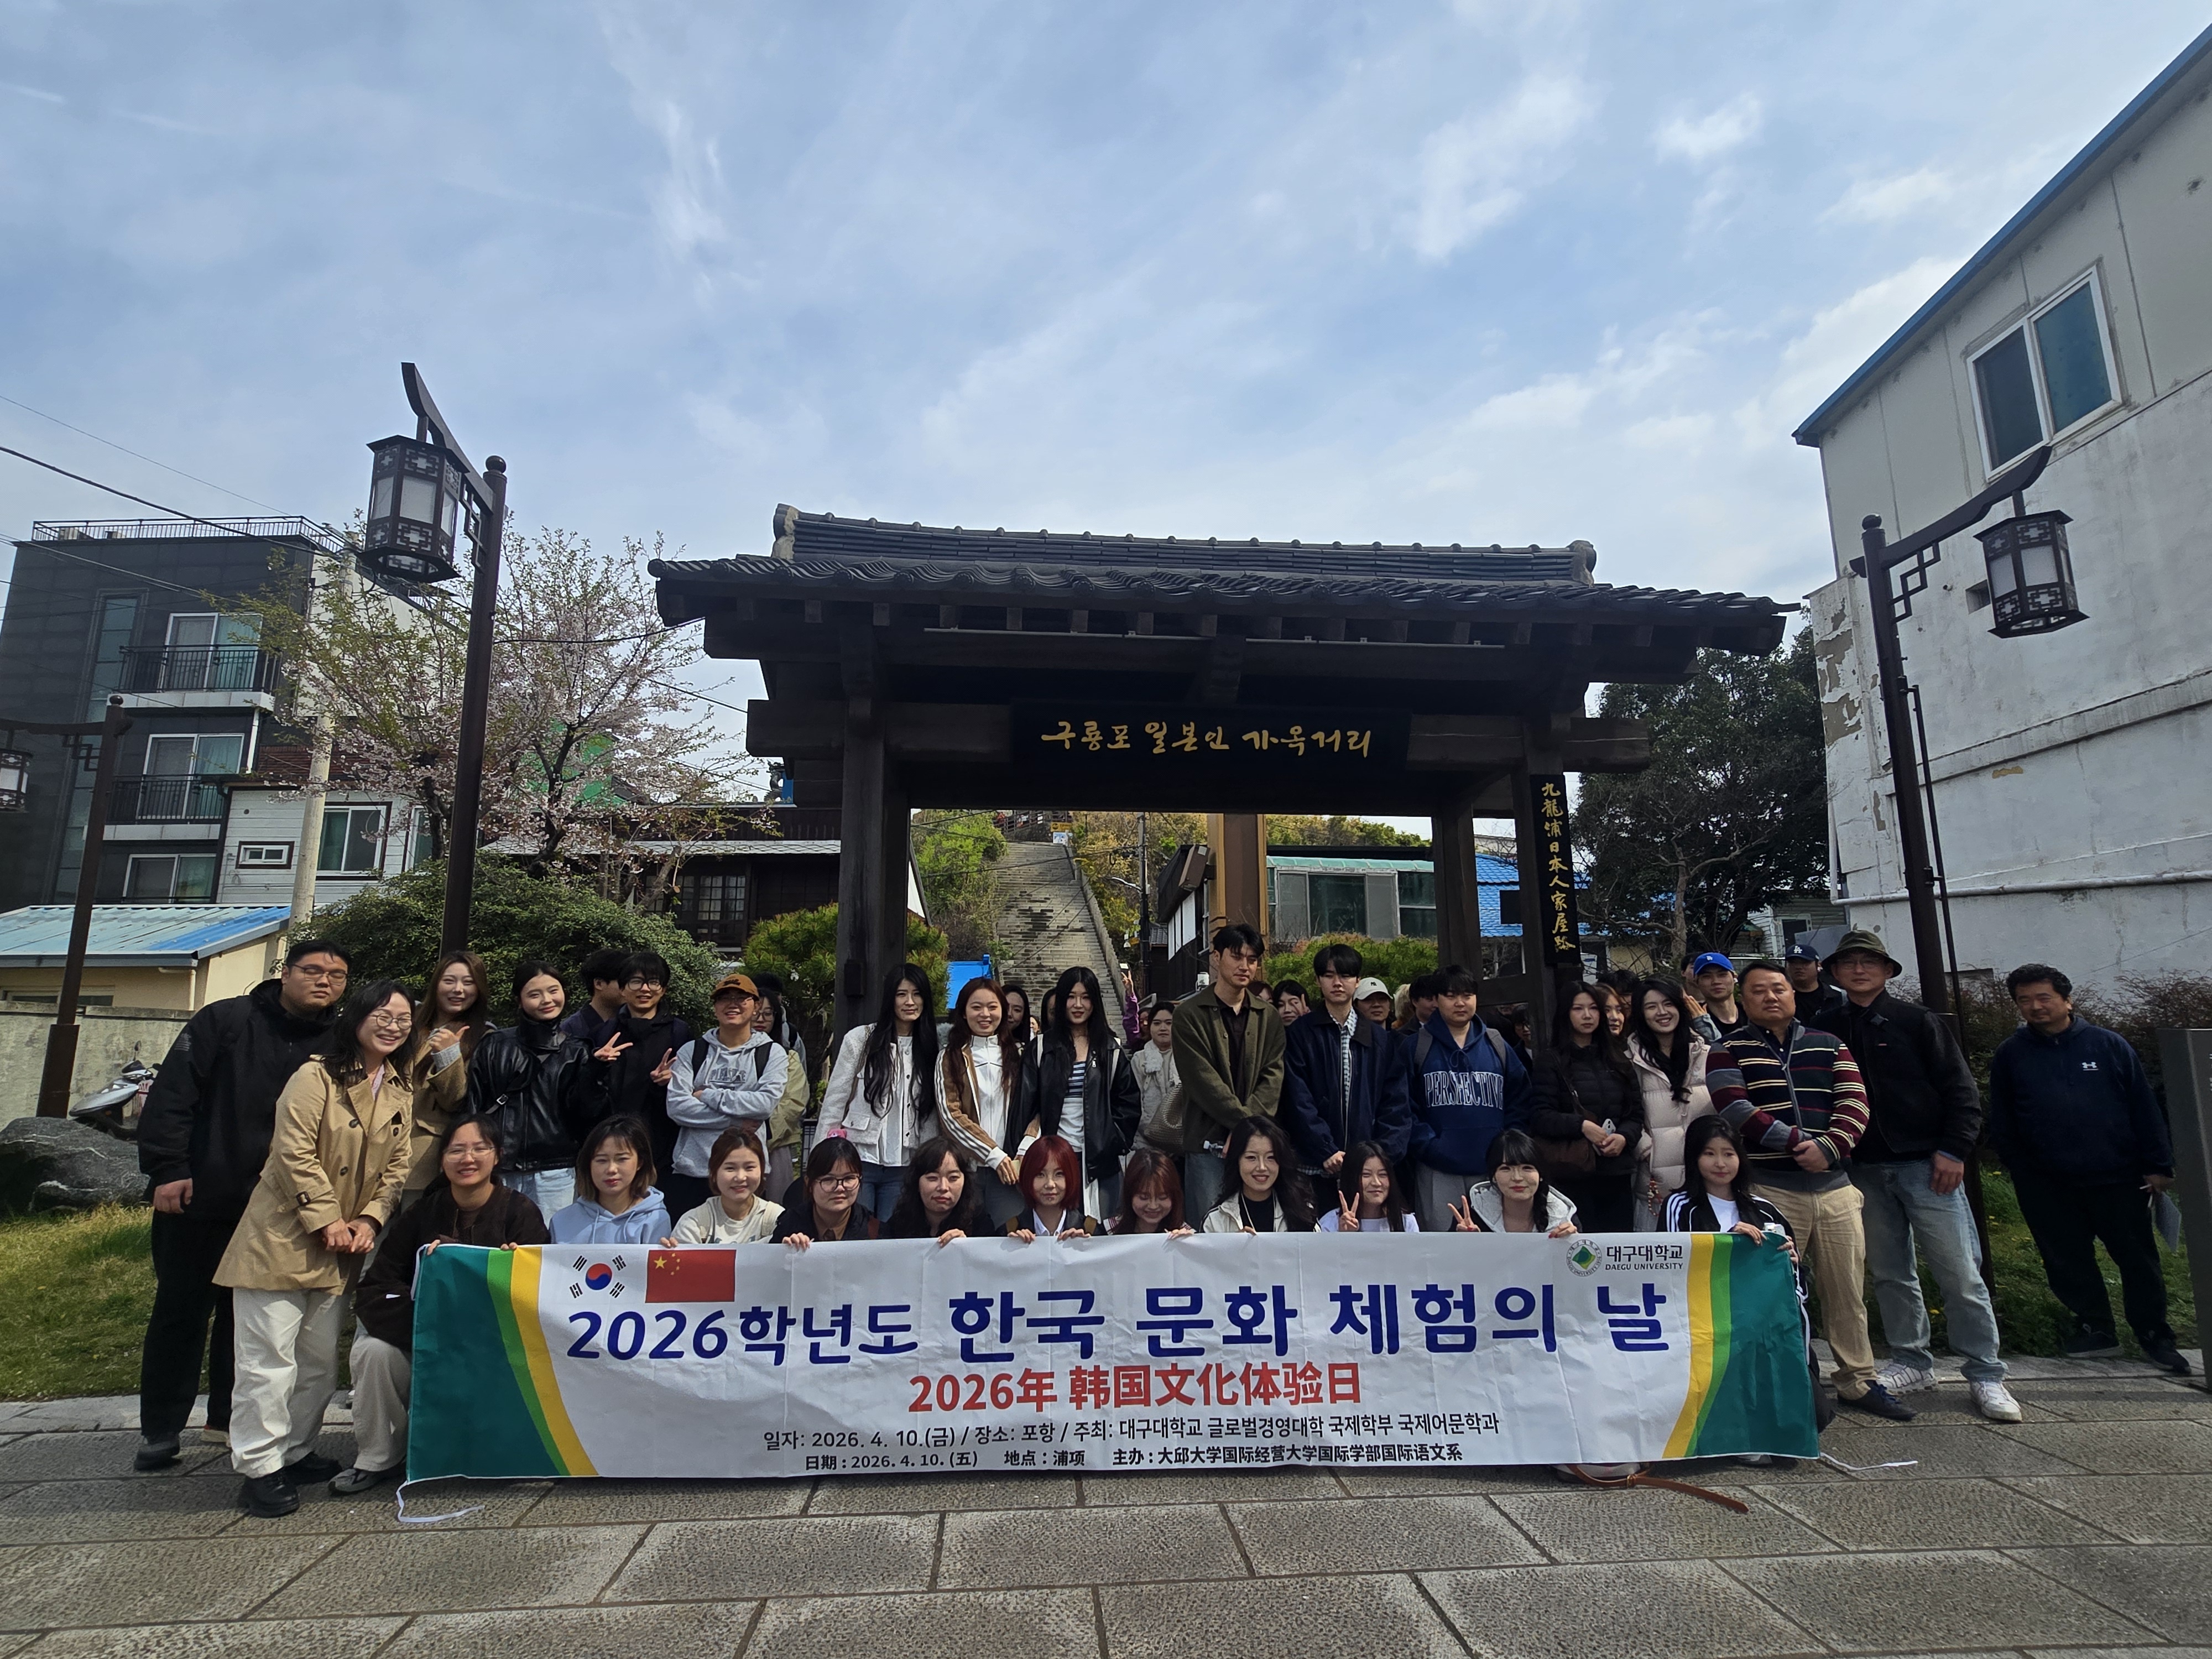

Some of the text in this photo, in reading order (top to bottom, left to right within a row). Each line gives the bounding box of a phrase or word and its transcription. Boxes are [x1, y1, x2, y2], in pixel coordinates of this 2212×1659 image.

[1042, 721, 1129, 750] 구룡포
[1145, 722, 1229, 754] 일본인
[1606, 1244, 1683, 1262] 대구대학교
[567, 1283, 1669, 1366] 2026학년도 한국 문화 체험의 날
[910, 1362, 1360, 1411] 2026年 韩国文化体验日
[764, 1430, 805, 1451] 일자:
[812, 1432, 864, 1448] 2026.
[870, 1431, 888, 1448] 4.
[960, 1426, 969, 1446] /
[974, 1425, 1015, 1445] 장소:
[1021, 1422, 1056, 1443] 포항
[1060, 1422, 1069, 1443] /
[1073, 1419, 1113, 1442] 주최:
[1119, 1416, 1203, 1440] 대구대학교
[1207, 1416, 1324, 1439] 글로벌경영대학
[1328, 1414, 1394, 1437] 국제학부
[1397, 1412, 1500, 1436] 국제어문학과
[851, 1455, 896, 1468] 2026.
[1052, 1449, 1086, 1467] 浦项
[1157, 1444, 1463, 1465] 大邱大学国际经营大学国际学部国际语文系
